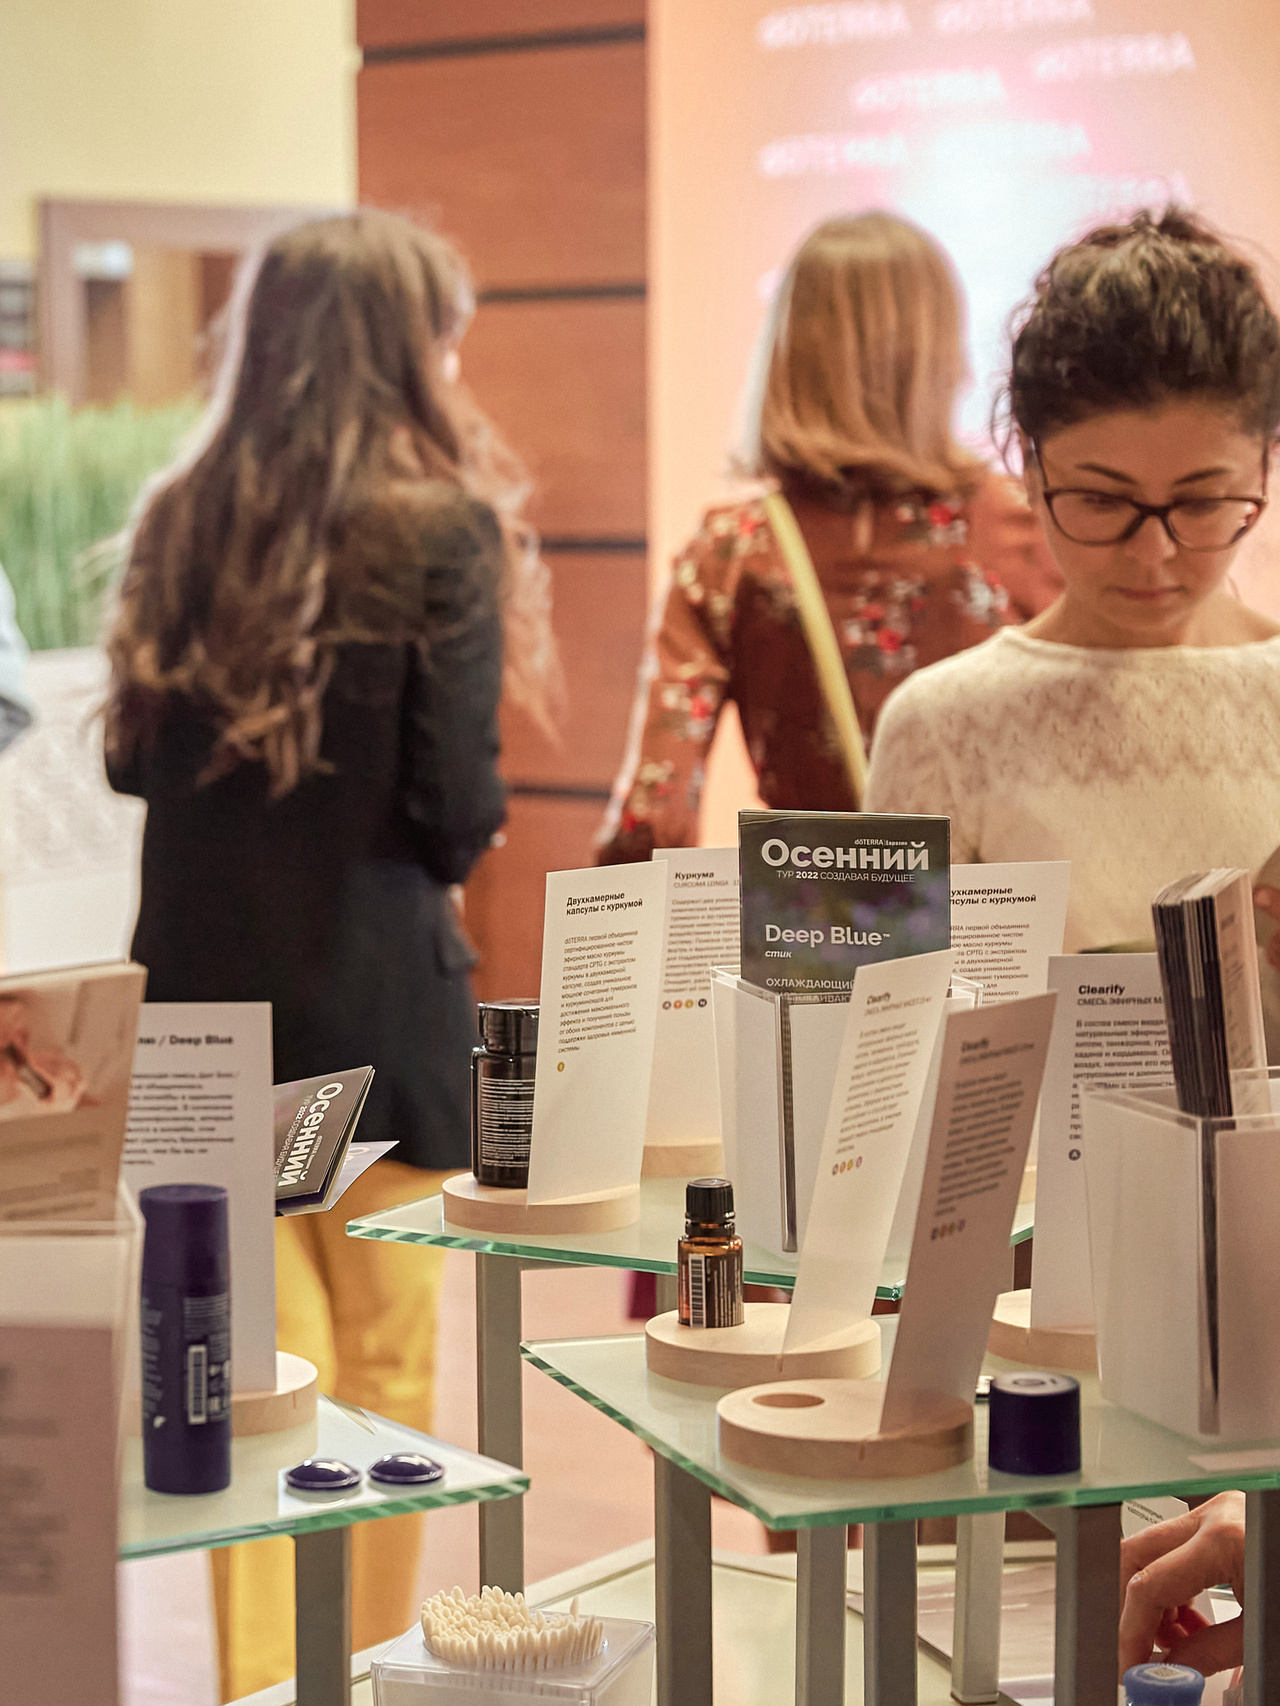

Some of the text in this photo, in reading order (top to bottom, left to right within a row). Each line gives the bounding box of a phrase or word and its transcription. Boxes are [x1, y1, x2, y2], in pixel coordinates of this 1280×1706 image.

[761, 838, 929, 871] Осенний
[675, 872, 714, 880] Куркума
[776, 870, 915, 883] ТУР 2022 СОЗДАВАЯ БУДУЩЕЕ
[951, 887, 1013, 897] ухкамерные
[566, 892, 625, 907] Двухкамерные
[951, 897, 979, 906] псулы
[989, 894, 1037, 904] куркумой
[566, 904, 599, 916] капсулы
[606, 898, 643, 912] куркумой
[765, 924, 825, 948] Deep
[765, 950, 792, 959] стик
[1078, 984, 1125, 996] Clearify
[137, 1036, 156, 1046] лю
[170, 1035, 202, 1047] Deep
[205, 1034, 233, 1045] Blue
[295, 1105, 307, 1120] 2022
[278, 1082, 344, 1187] Осенний
